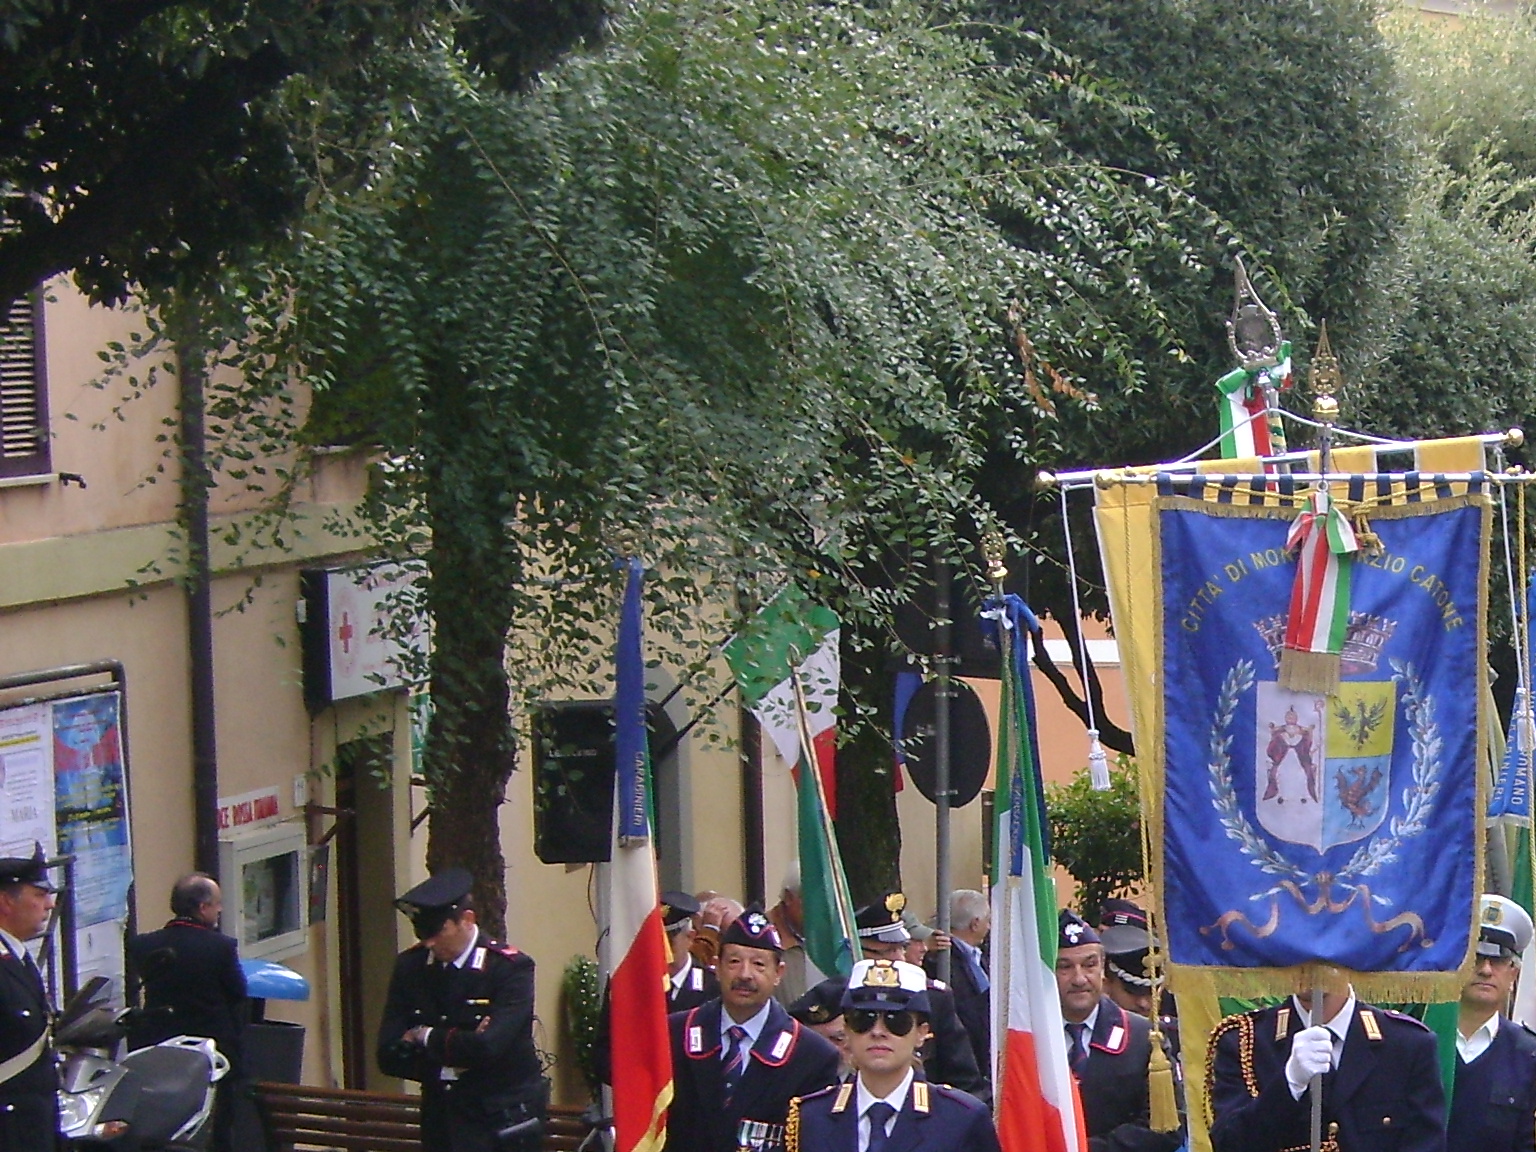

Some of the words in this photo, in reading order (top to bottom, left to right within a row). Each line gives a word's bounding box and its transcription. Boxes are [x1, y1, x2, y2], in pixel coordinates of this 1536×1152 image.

[1180, 574, 1223, 633] CITTA'
[1223, 559, 1248, 583] DI
[1410, 565, 1465, 632] CATONE
[633, 752, 645, 827] CARABINIERI
